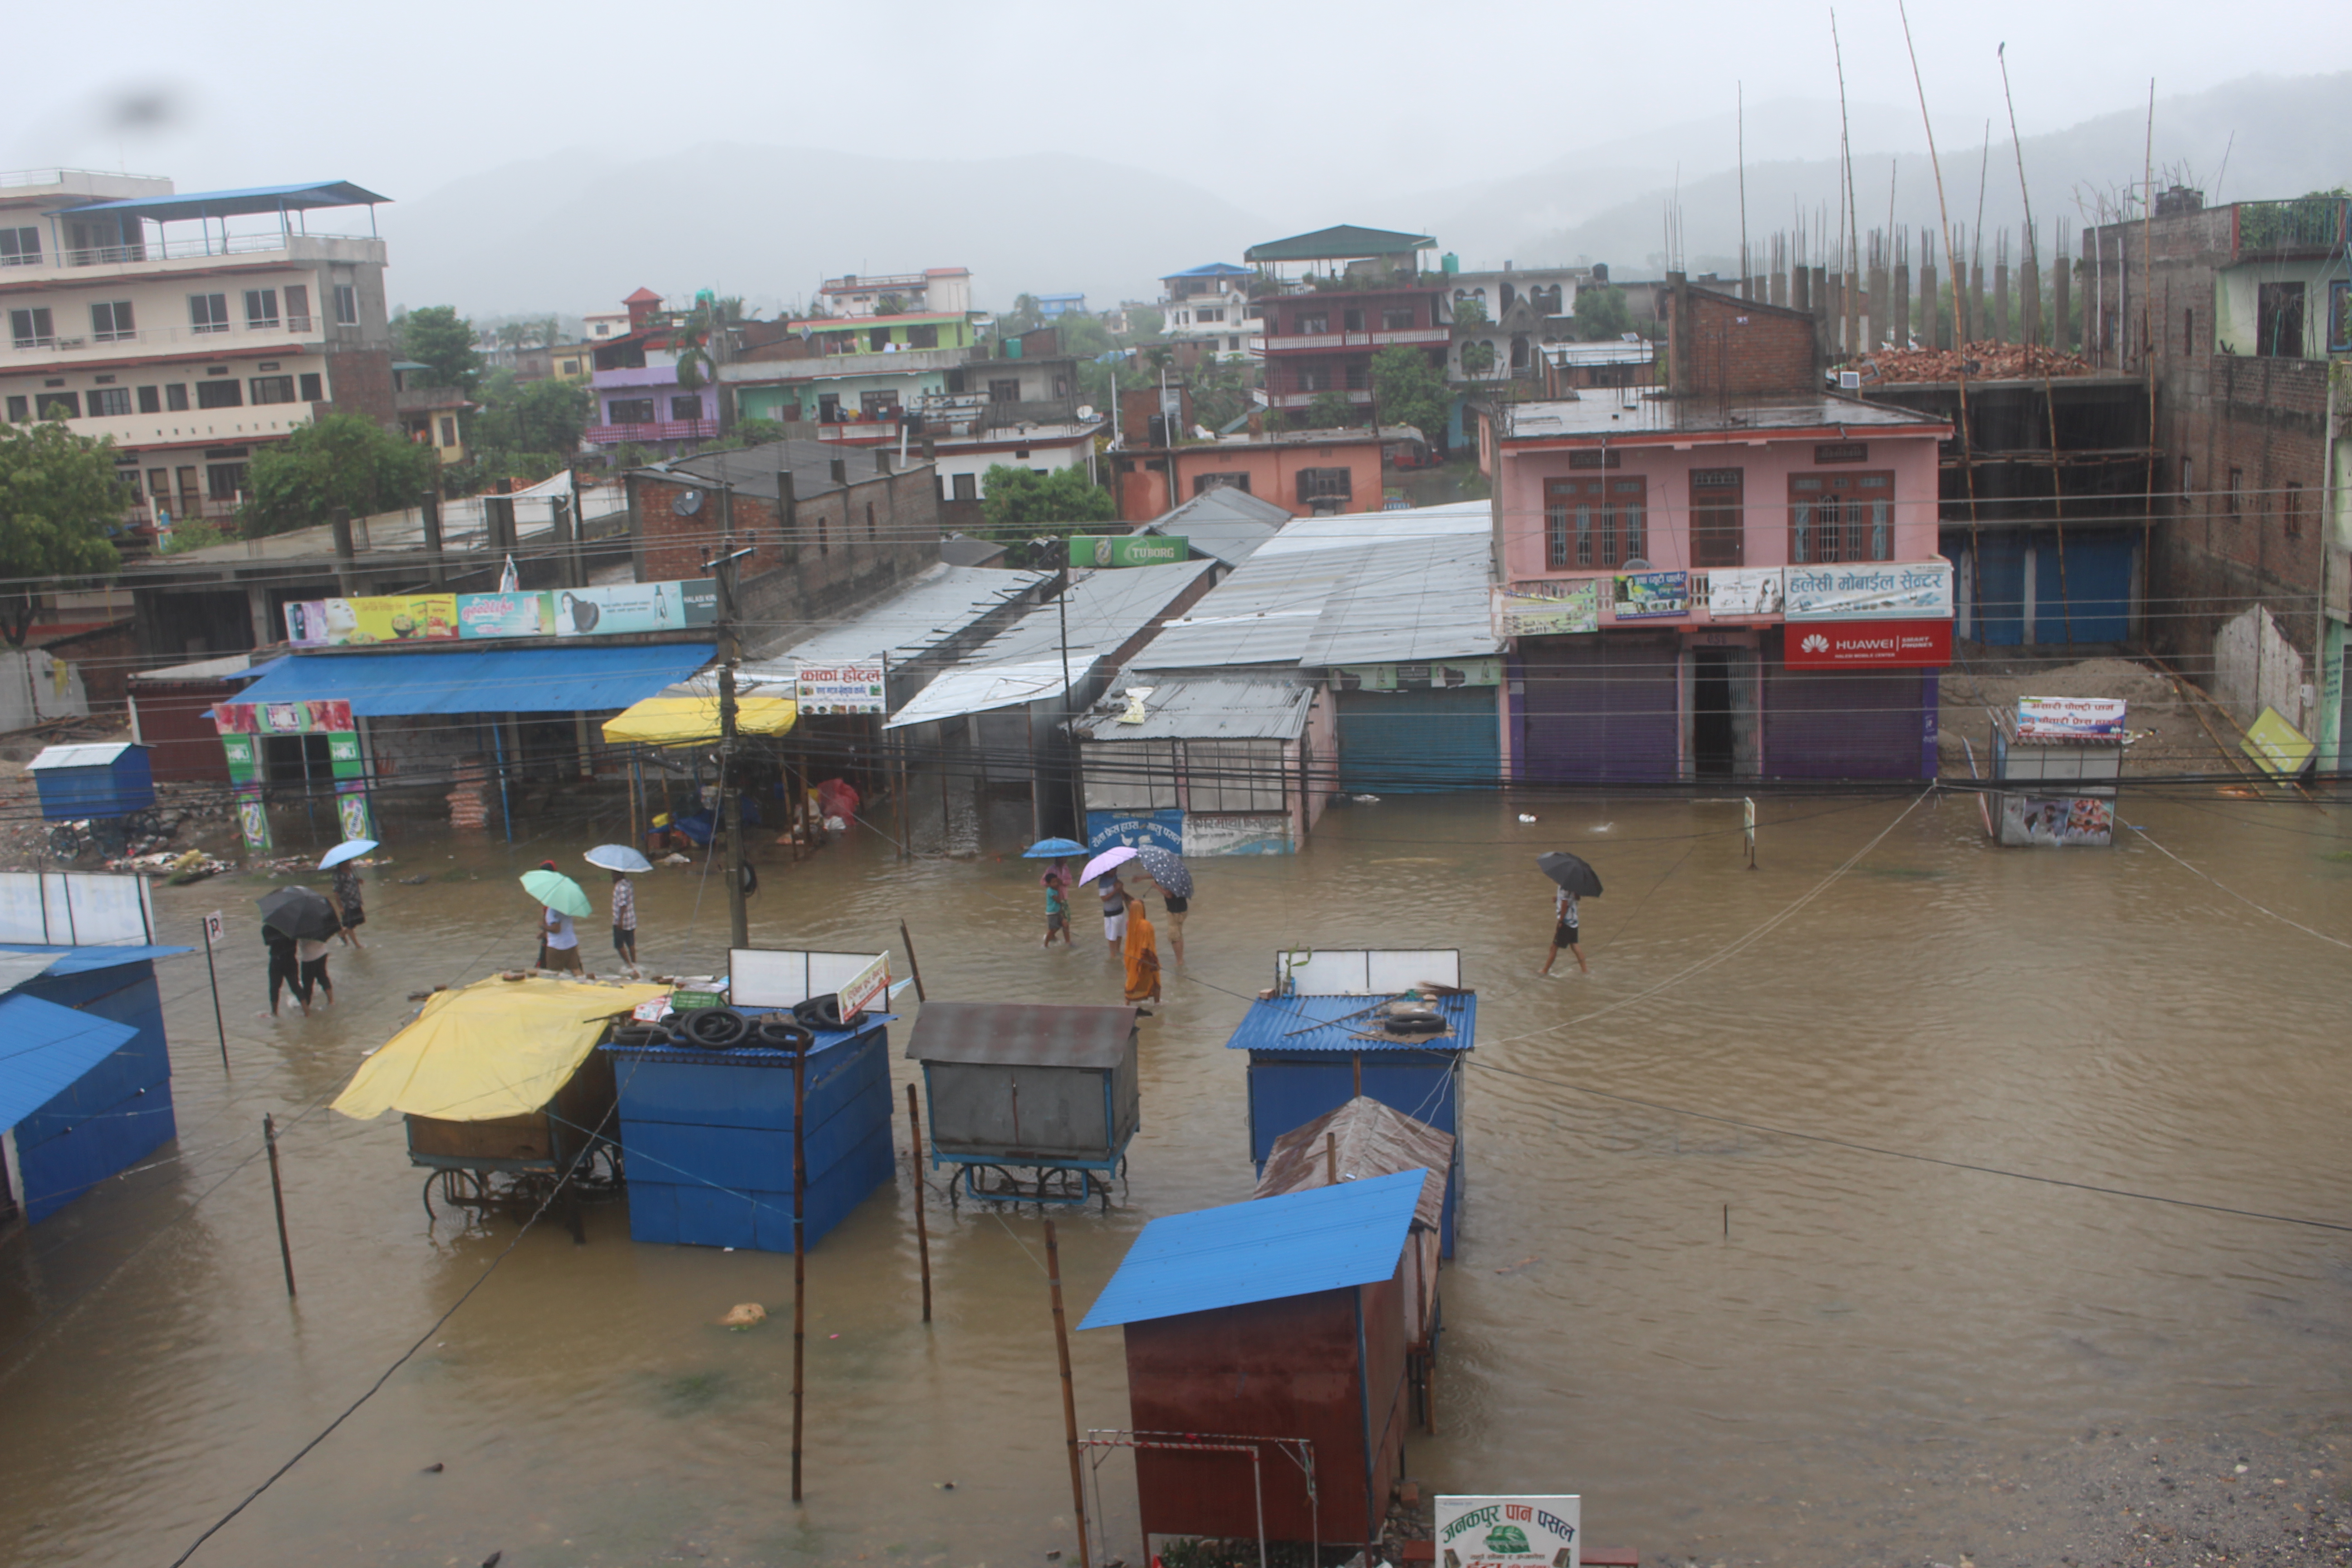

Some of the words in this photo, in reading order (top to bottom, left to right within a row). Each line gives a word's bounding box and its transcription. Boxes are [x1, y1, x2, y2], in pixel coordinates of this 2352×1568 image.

[1132, 547, 1174, 558] TUBORG
[1790, 573, 1833, 593] हलेसी
[1838, 572, 1895, 591] मोबाईल
[1836, 639, 1893, 650] HUAWEI
[801, 669, 838, 681] काका
[843, 666, 880, 682] होटल
[1440, 1504, 1501, 1544] जनकपुर
[1505, 1504, 1534, 1523] पान
[1537, 1509, 1576, 1543] पसल
